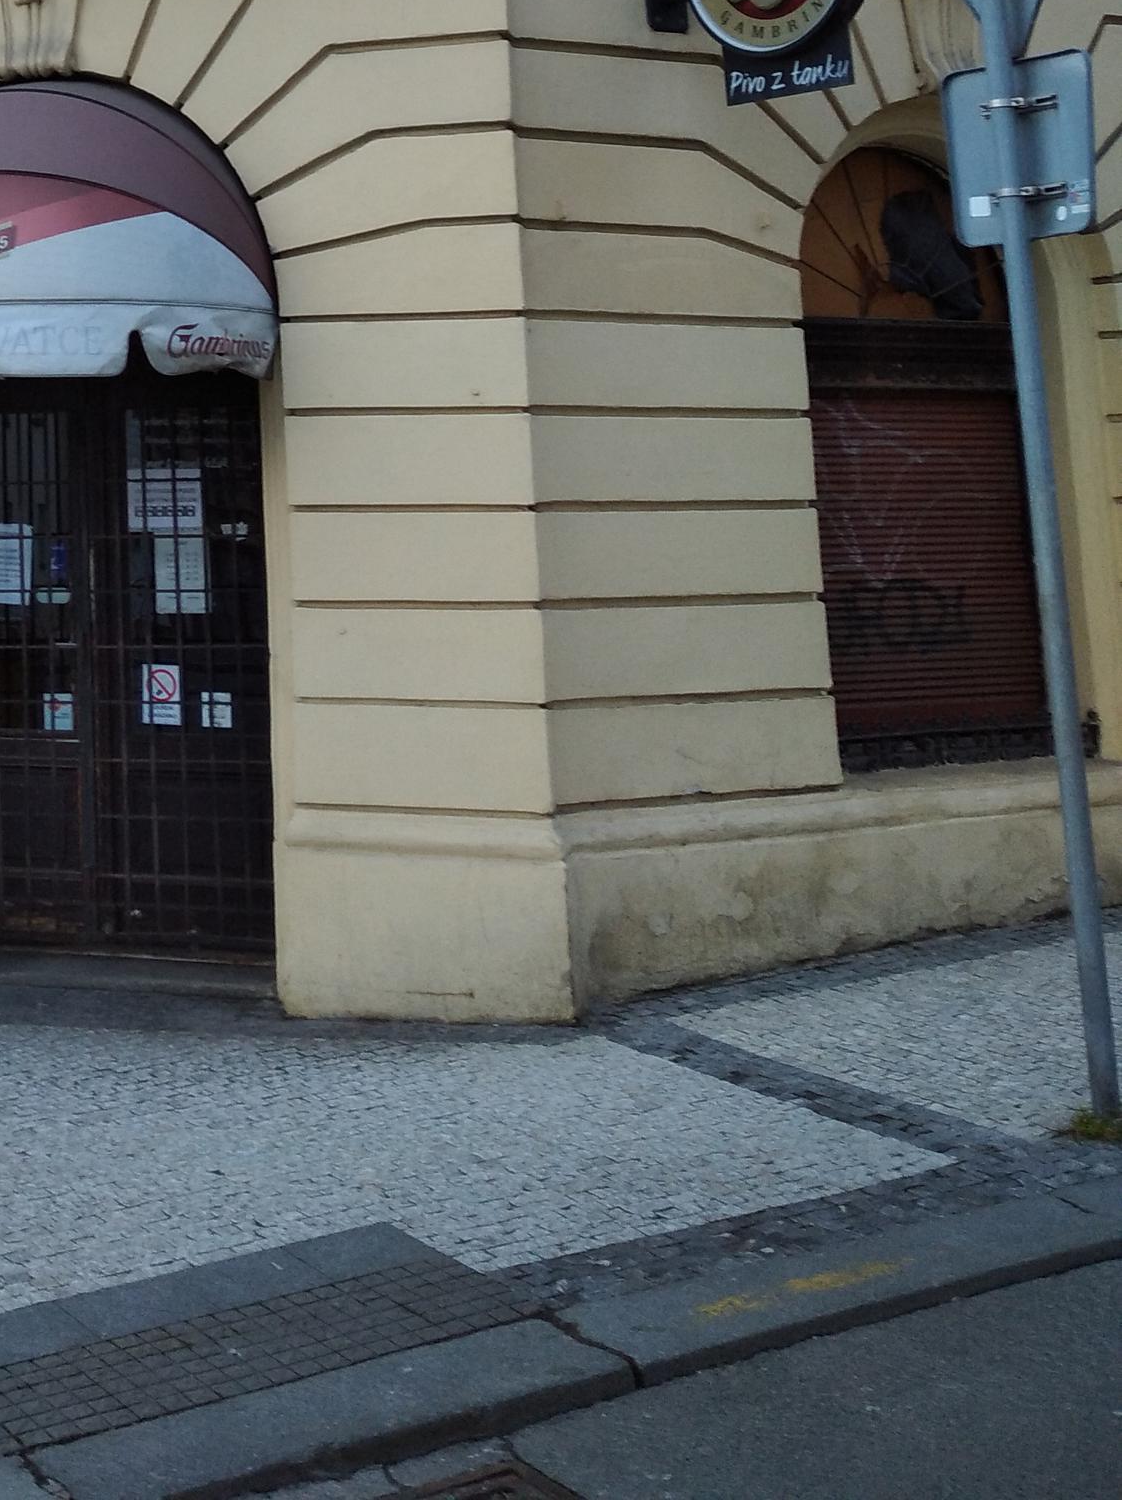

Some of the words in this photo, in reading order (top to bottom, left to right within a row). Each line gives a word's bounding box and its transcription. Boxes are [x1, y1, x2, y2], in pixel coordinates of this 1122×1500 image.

[729, 70, 766, 97] Pivo
[790, 53, 850, 87] tanku
[166, 323, 271, 360] Gambrinus
